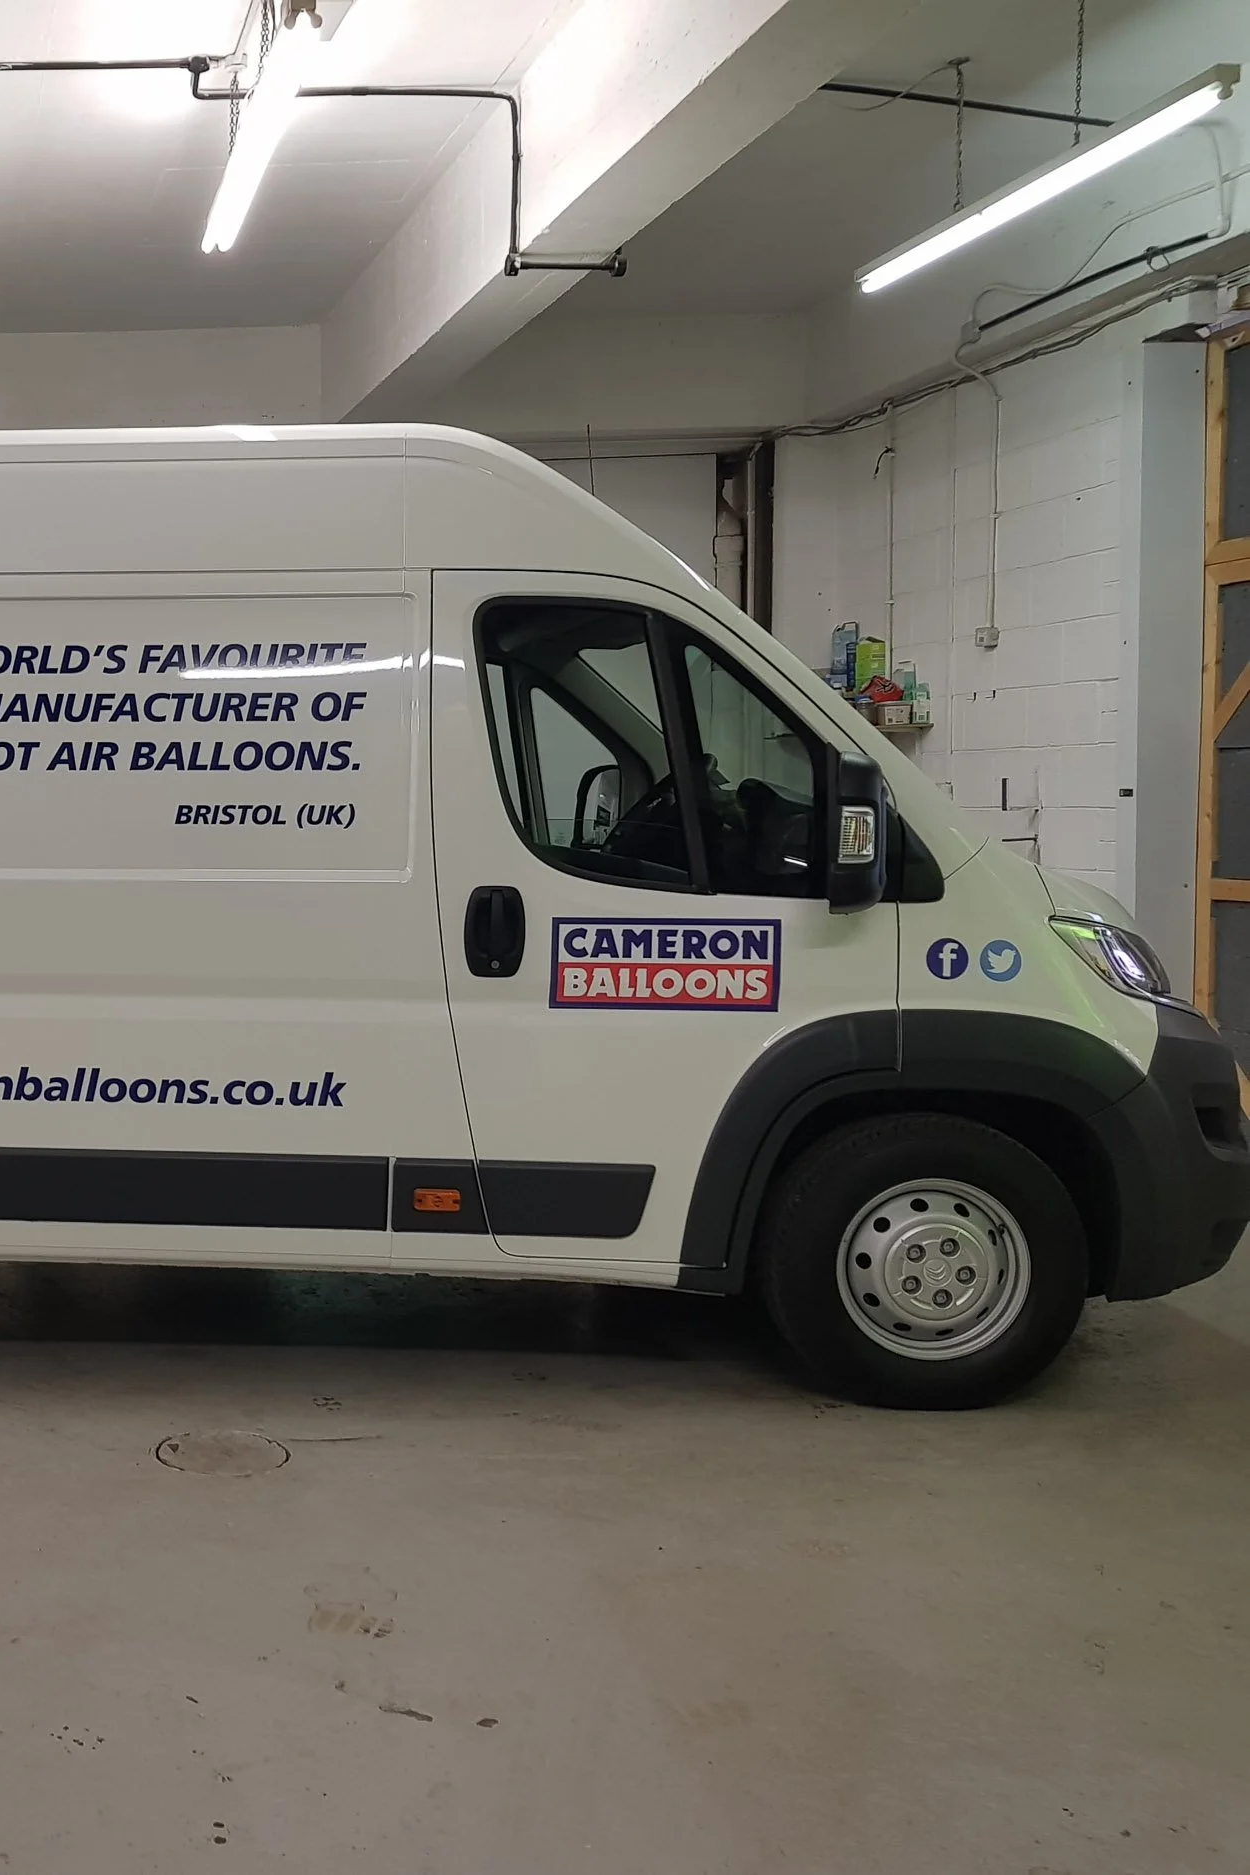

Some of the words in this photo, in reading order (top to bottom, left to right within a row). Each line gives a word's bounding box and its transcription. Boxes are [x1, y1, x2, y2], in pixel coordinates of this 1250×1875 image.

[137, 642, 368, 674] FAVOURITE
[310, 691, 368, 722] OF
[45, 741, 120, 771] AIR
[129, 740, 361, 772] BALLOONS.
[174, 804, 287, 826] BRISTOL
[296, 803, 356, 830] (UK)
[563, 927, 769, 960] CAMERON
[563, 967, 768, 1000] BALLOONS
